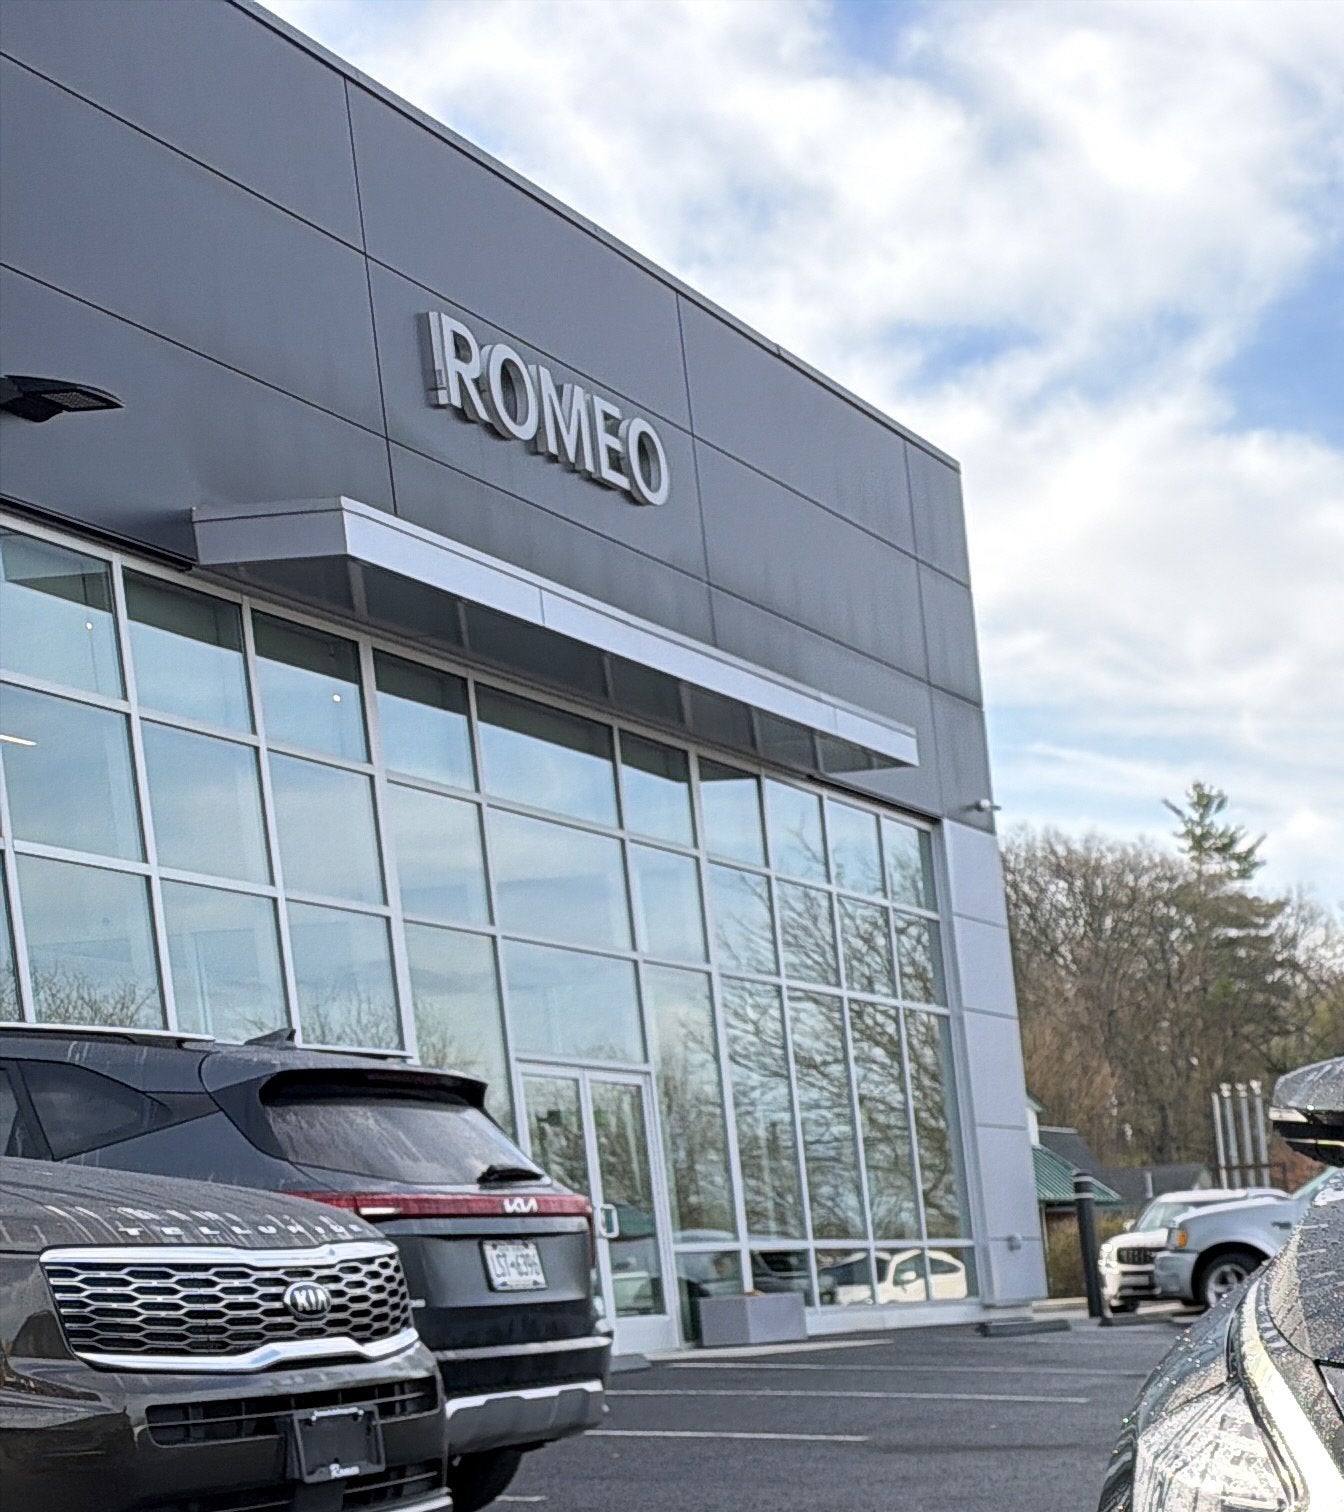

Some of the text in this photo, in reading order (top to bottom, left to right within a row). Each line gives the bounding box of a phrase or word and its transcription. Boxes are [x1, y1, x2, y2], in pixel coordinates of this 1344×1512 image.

[428, 311, 670, 507] ROMEO
[503, 1197, 538, 1213] KIA
[293, 1288, 331, 1311] KIA
